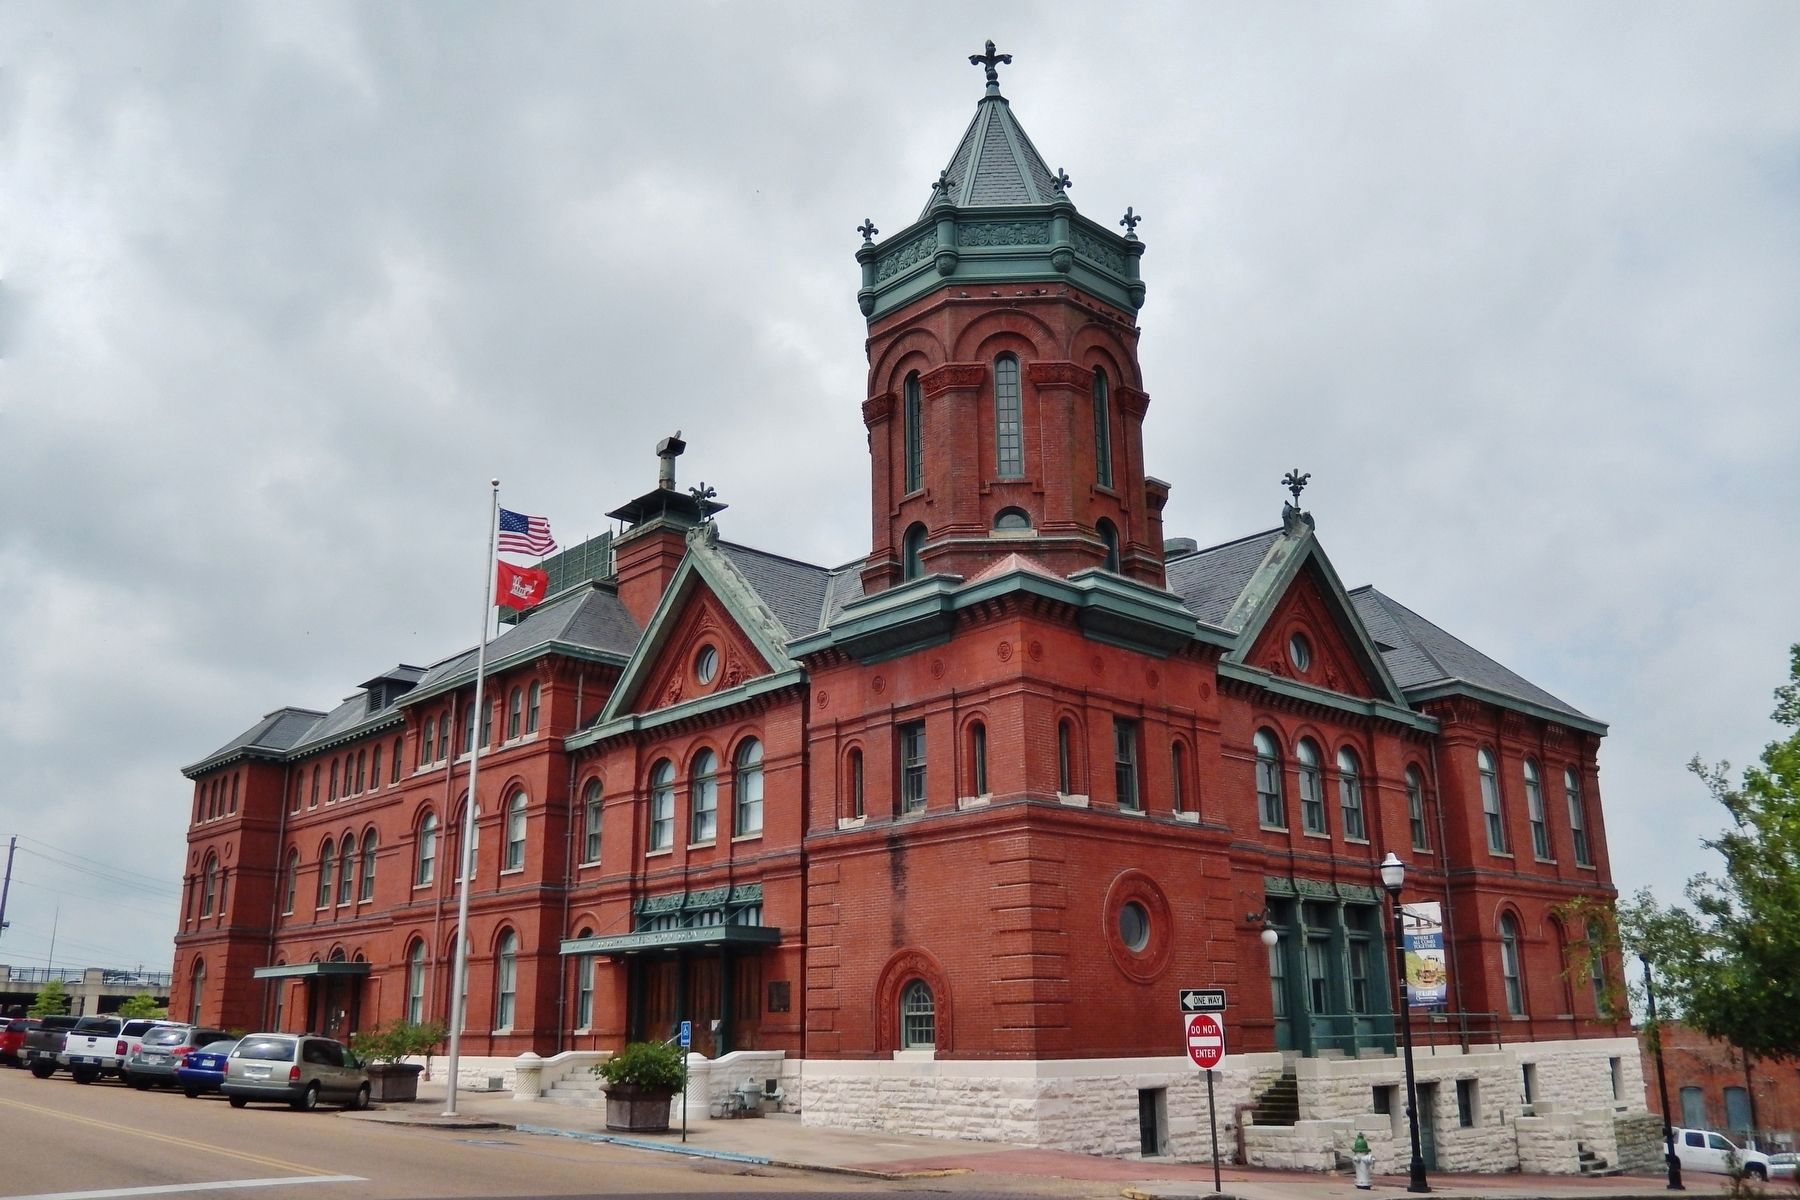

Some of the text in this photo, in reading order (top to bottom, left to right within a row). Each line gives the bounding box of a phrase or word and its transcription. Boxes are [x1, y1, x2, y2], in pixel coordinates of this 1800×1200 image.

[1193, 996, 1221, 1005] ONE WAY
[1191, 1025, 1216, 1034] DO NOT
[1195, 1049, 1217, 1058] ENTER
